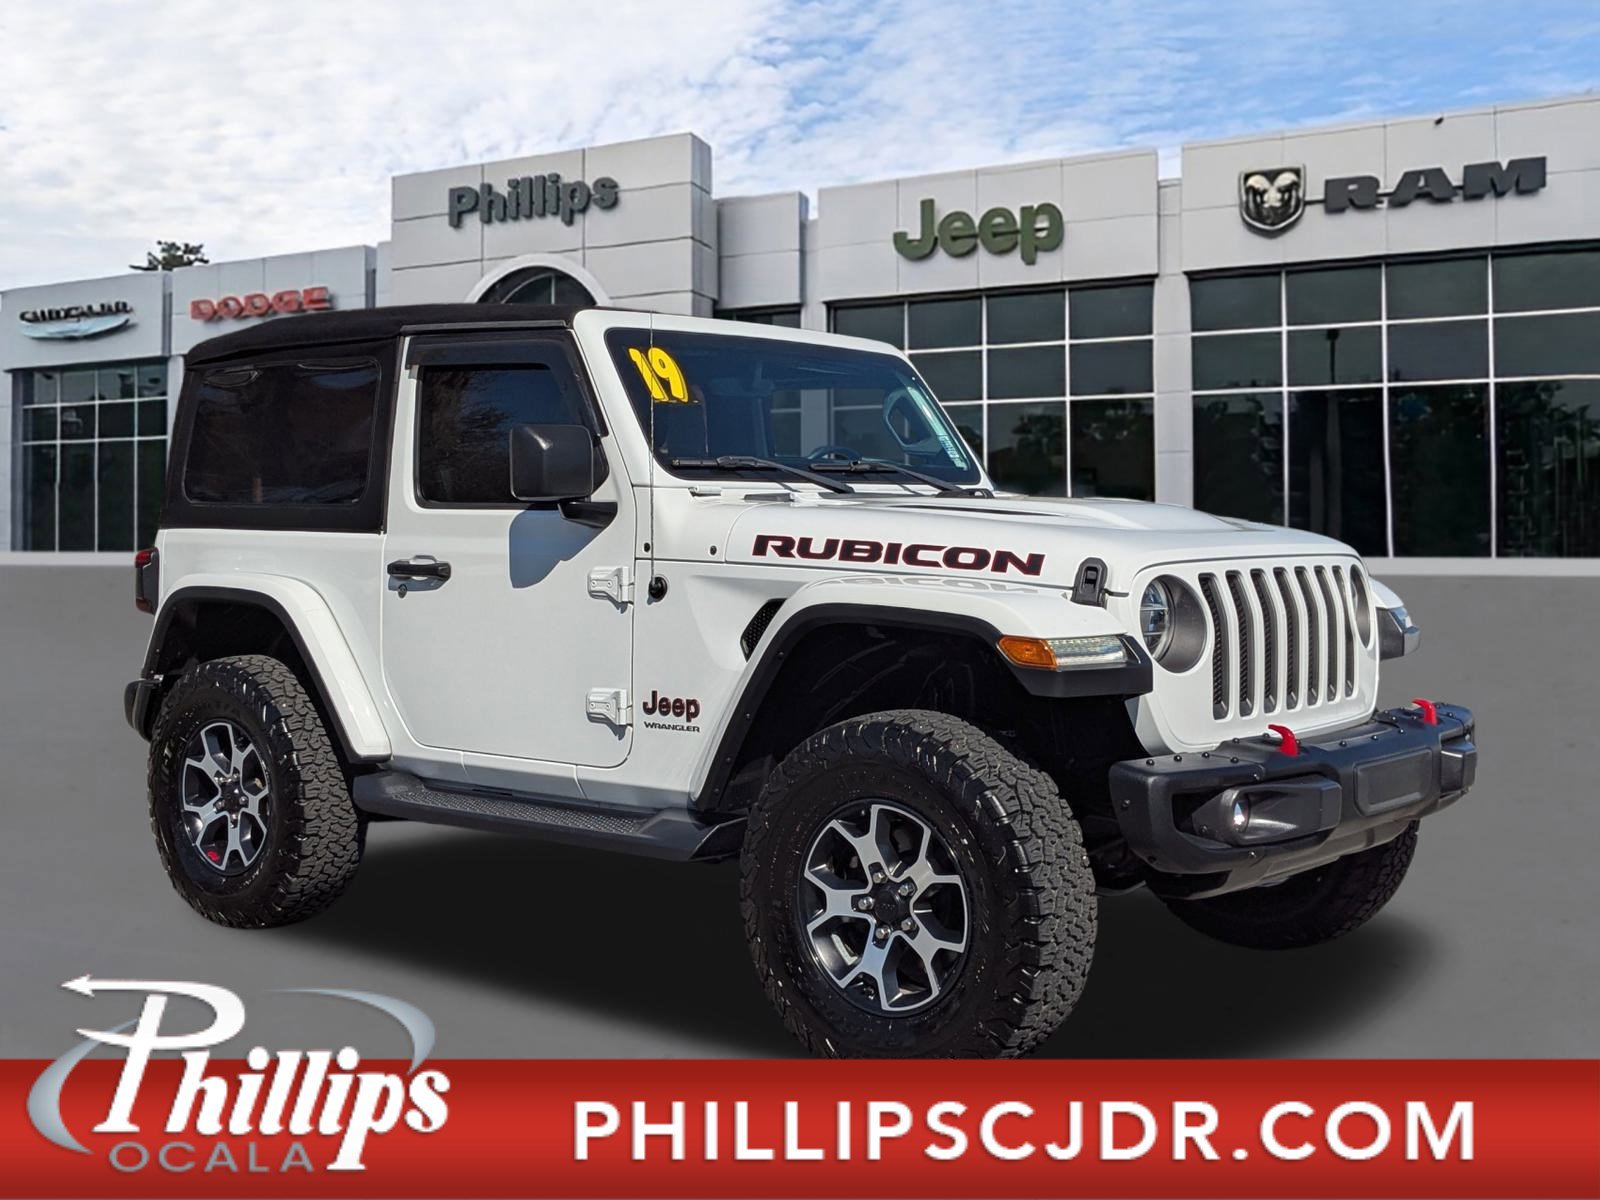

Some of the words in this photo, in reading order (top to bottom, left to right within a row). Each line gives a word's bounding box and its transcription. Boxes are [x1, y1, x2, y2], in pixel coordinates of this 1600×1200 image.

[448, 173, 620, 229] Phillips
[1325, 156, 1547, 214] RAM
[893, 198, 1065, 266] Jeep
[190, 286, 332, 322] DODGE
[628, 347, 689, 403] 19
[752, 534, 1046, 577] RUBICON
[642, 690, 701, 723] Jeep
[643, 721, 701, 733] WRANGLER
